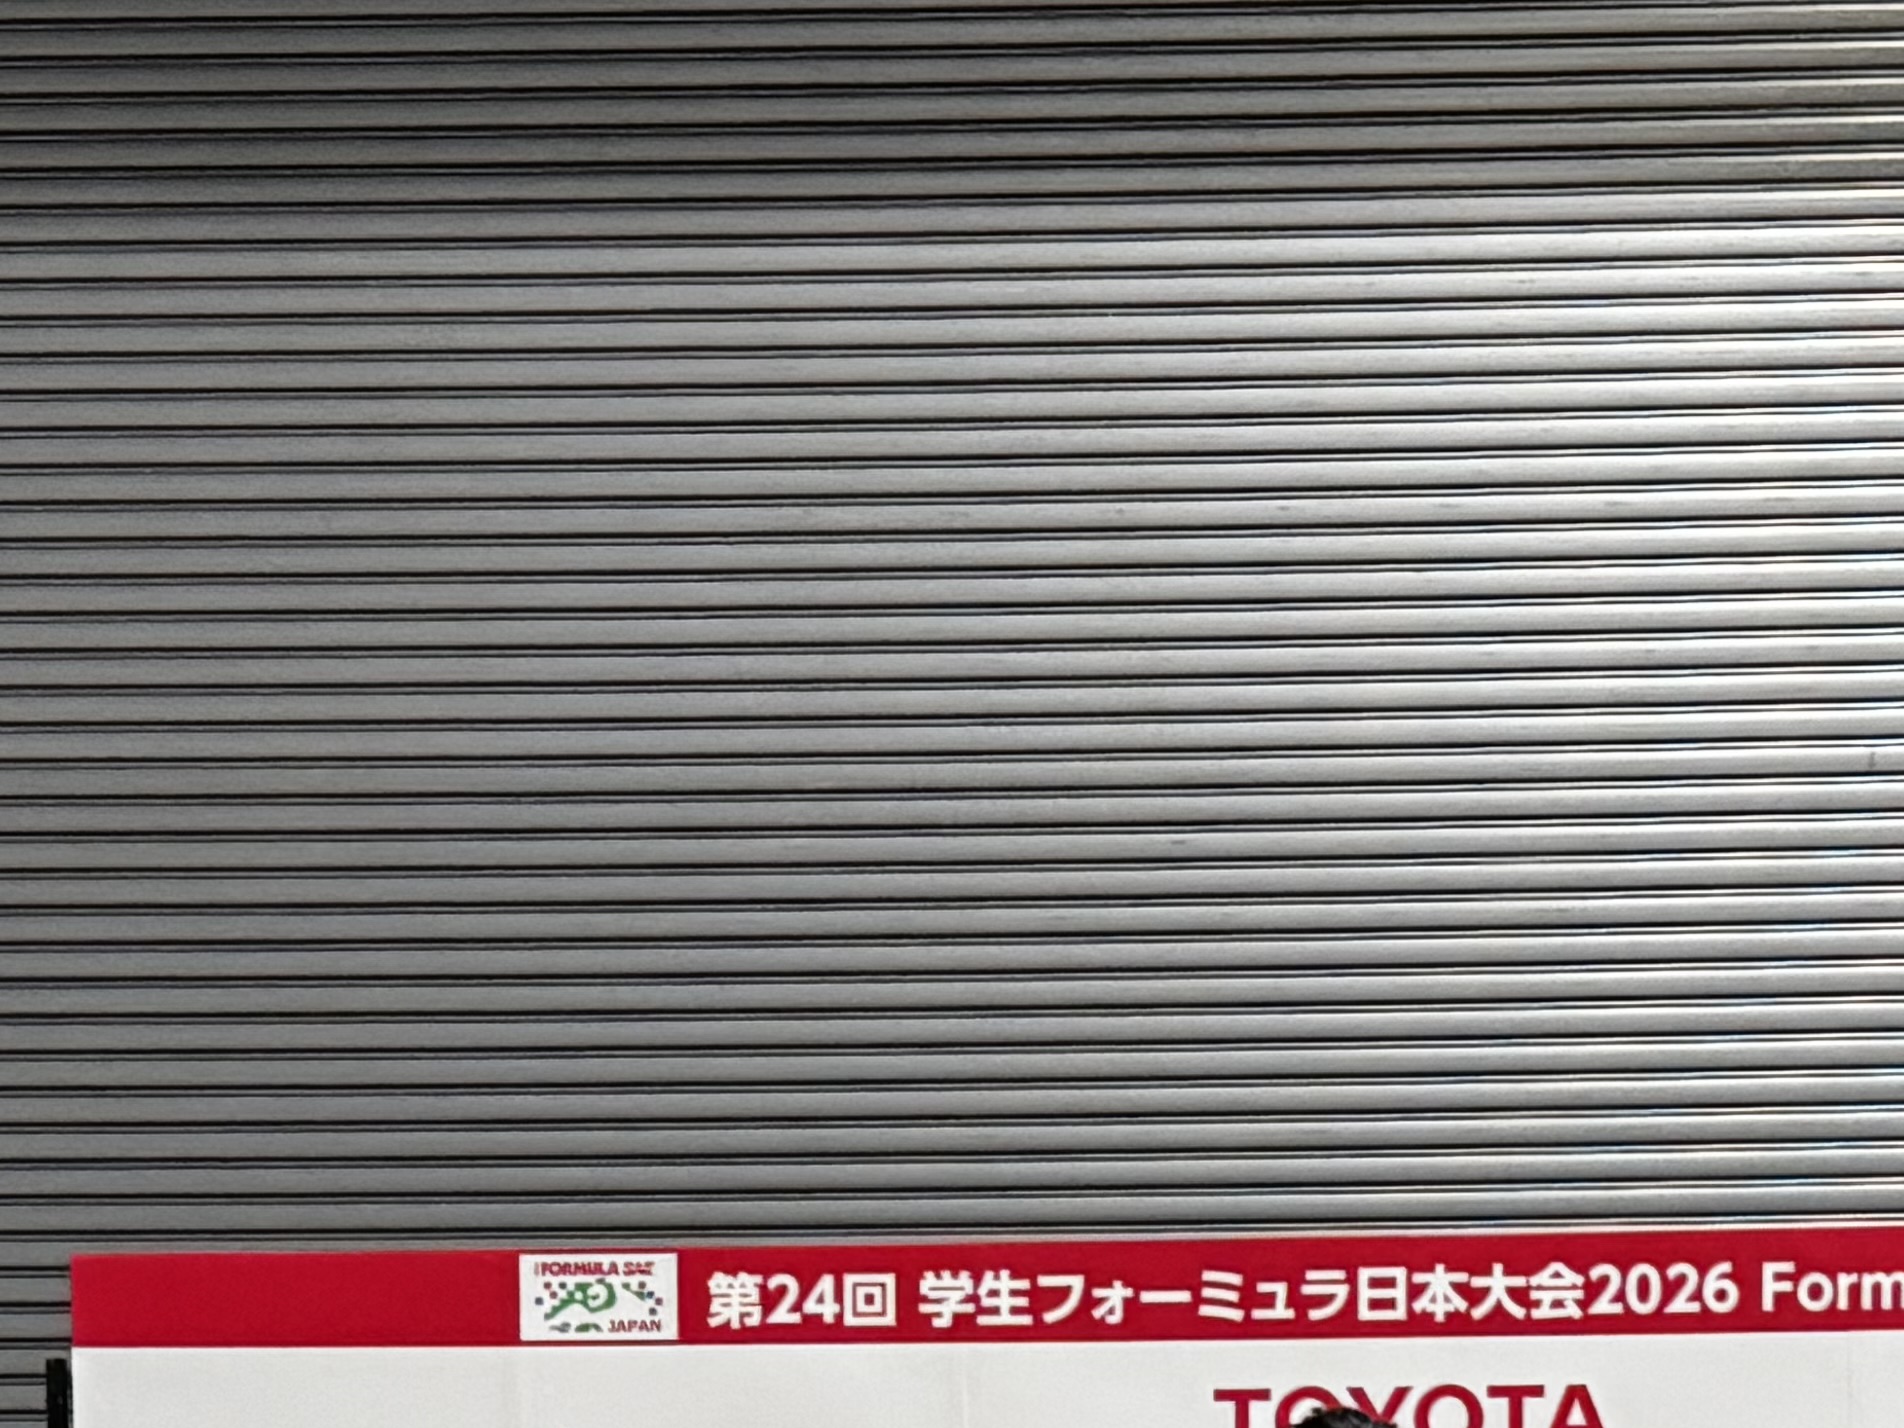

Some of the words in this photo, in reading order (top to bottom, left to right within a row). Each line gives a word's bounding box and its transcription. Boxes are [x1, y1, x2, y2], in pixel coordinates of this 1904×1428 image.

[707, 1269, 897, 1330] 第24回
[918, 1258, 1740, 1330] 学生フォーミュラ日本大会2026
[608, 1319, 662, 1333] JAPAN
